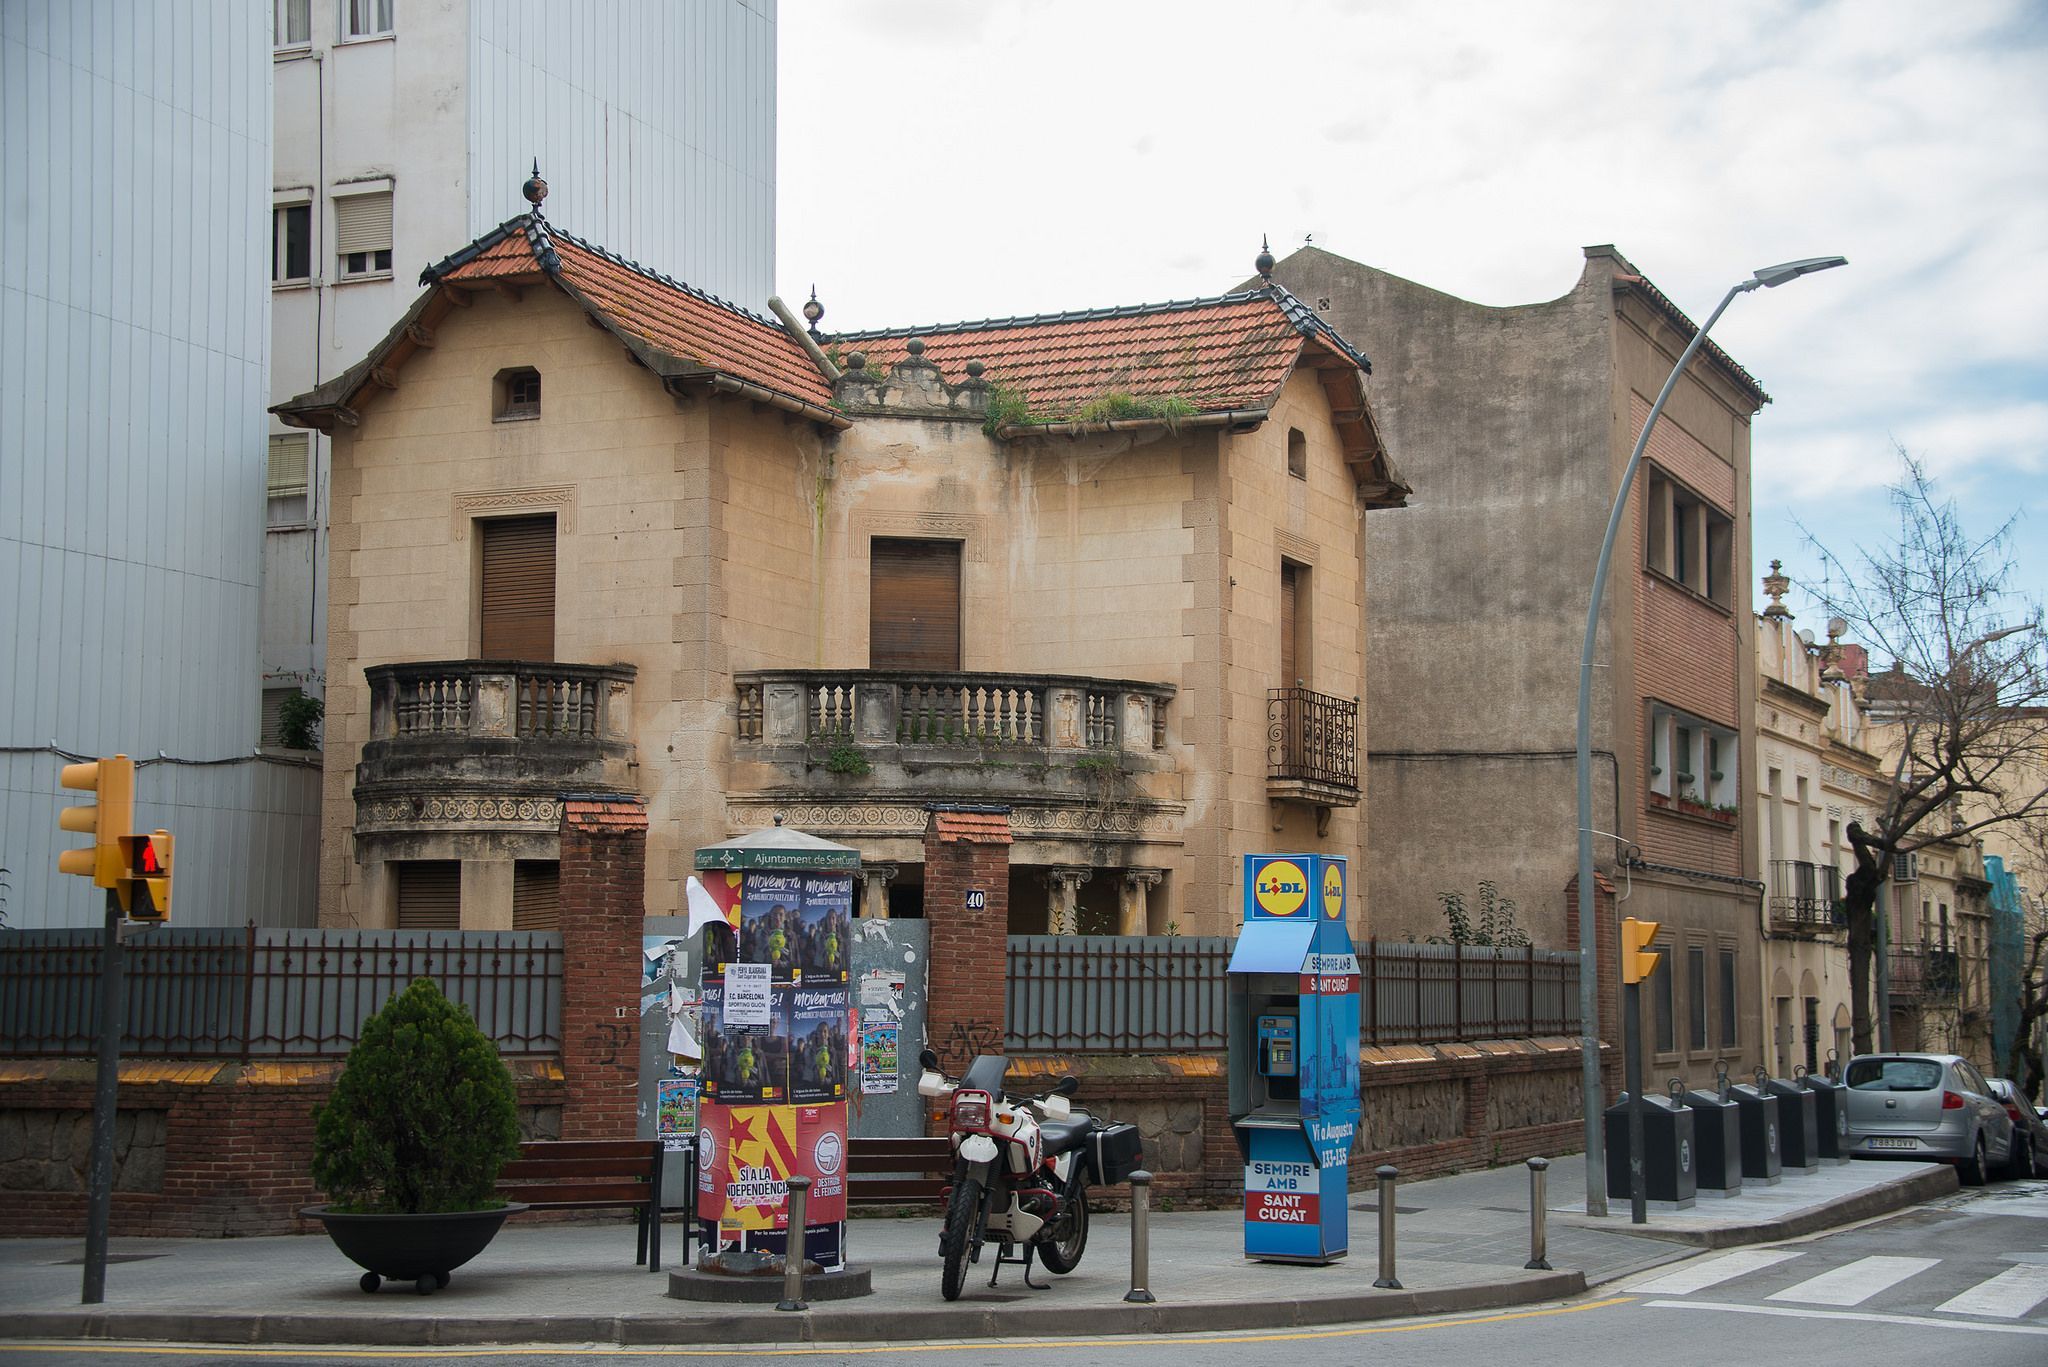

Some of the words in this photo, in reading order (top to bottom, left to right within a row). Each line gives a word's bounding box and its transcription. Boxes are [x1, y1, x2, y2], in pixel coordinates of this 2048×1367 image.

[754, 853, 811, 865] Ajuntament
[813, 854, 825, 865] de
[967, 893, 984, 908] 40
[1312, 957, 1338, 970] SEMPRE
[1339, 957, 1350, 970] AMB
[1312, 1123, 1326, 1142] Via
[1326, 1120, 1352, 1144] Augusta
[1322, 1147, 1347, 1168] 133-135
[740, 1166, 749, 1182] SÍ
[750, 1168, 758, 1181] A
[759, 1167, 771, 1180] LA
[1255, 1163, 1310, 1177] SEMPRE
[726, 1179, 789, 1197] NDEPENDÈNCIA
[1266, 1177, 1298, 1190] AMB
[814, 1188, 821, 1197] EL
[1264, 1194, 1301, 1208] SANT
[1258, 1208, 1307, 1222] CUGAT
